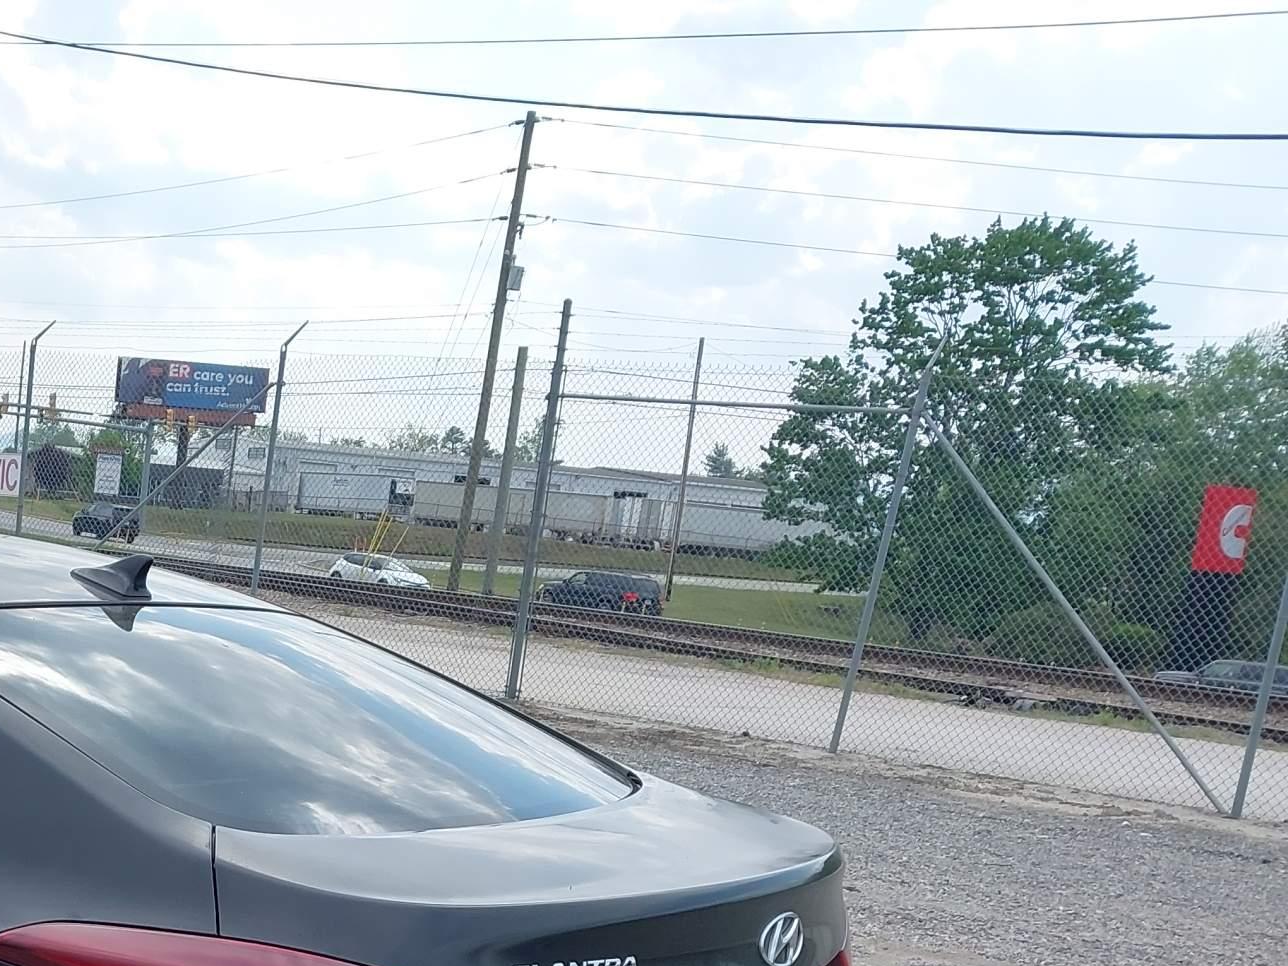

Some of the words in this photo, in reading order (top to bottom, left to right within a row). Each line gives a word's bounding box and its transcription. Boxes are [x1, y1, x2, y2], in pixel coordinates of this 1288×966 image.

[168, 363, 191, 378] ER
[193, 370, 224, 382] care
[227, 373, 254, 386] you
[166, 382, 192, 393] can
